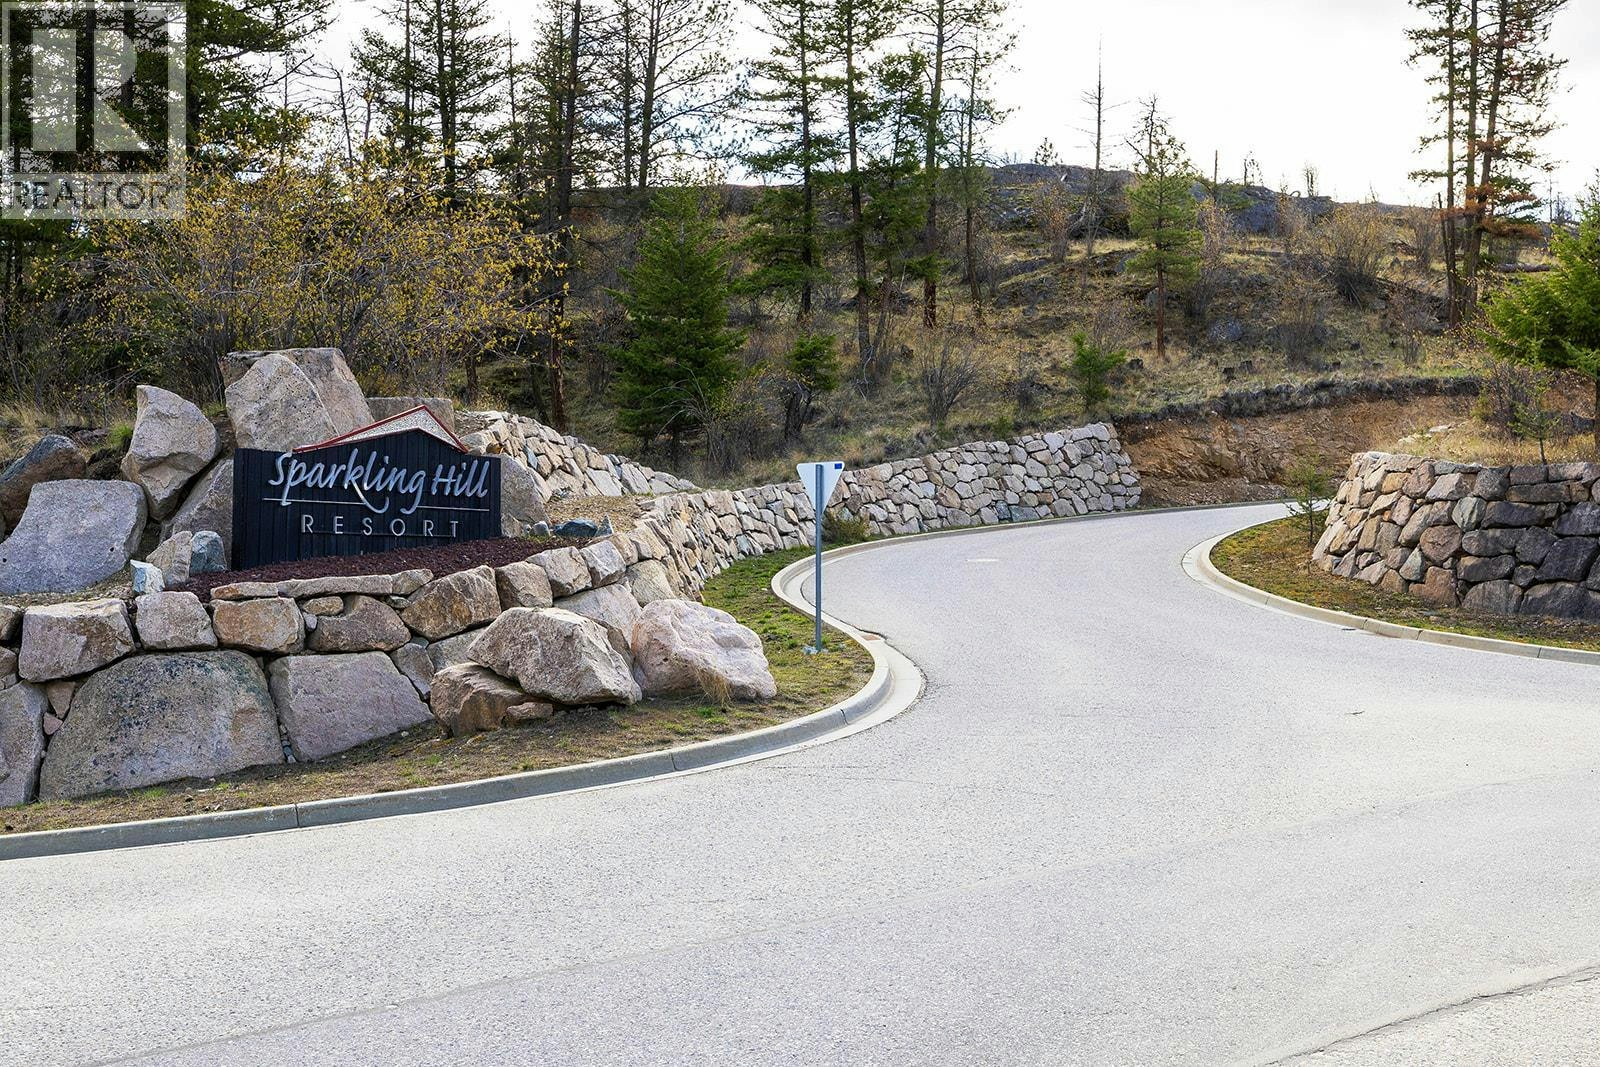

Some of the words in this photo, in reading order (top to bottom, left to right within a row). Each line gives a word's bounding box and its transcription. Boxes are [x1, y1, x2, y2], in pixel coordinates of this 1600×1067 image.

[268, 448, 426, 515] Sparkling
[430, 459, 489, 498] Hill
[301, 514, 459, 538] RESORT
